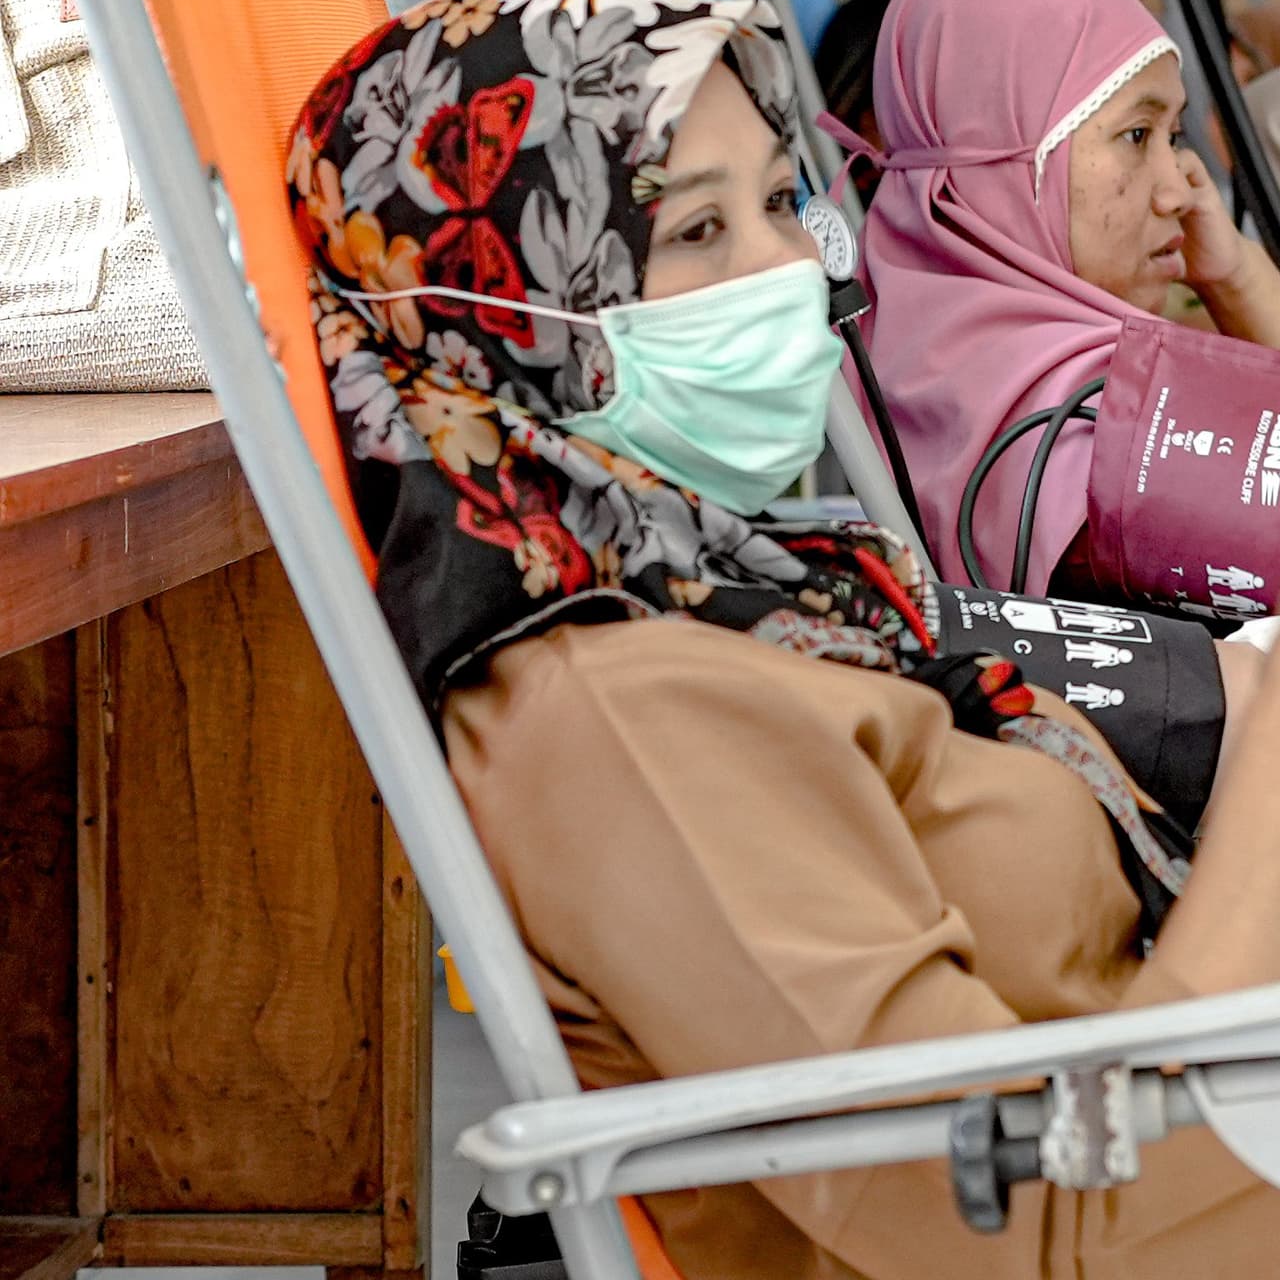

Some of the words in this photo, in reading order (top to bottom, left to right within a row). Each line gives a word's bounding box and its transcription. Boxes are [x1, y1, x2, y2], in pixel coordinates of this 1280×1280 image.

[1137, 387, 1169, 493] www.abnmedical.com
[1245, 433, 1266, 477] PRESSURE
[1240, 477, 1254, 504] CUFF
[1014, 639, 1032, 655] C
